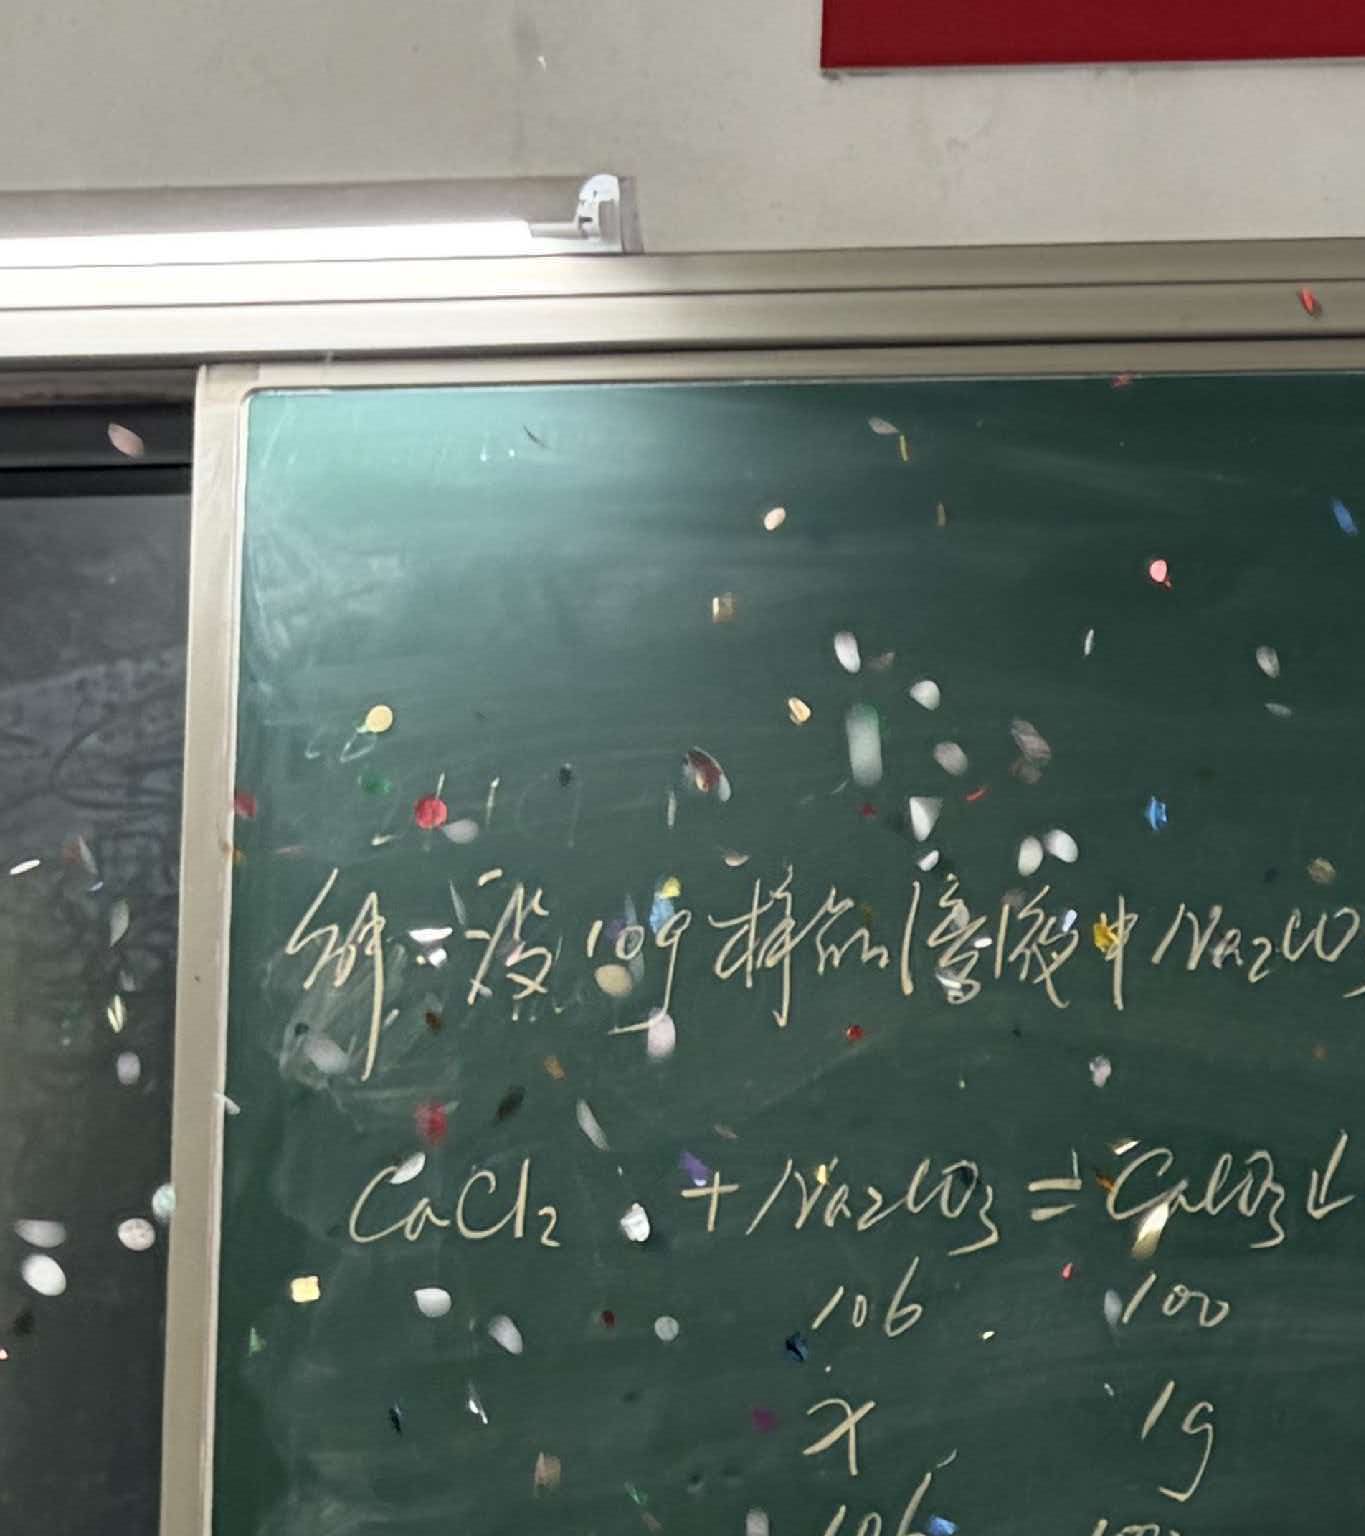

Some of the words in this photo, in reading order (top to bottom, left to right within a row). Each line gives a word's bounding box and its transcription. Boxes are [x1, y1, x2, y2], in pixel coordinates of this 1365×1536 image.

[811, 1257, 923, 1337] 106
[1122, 1273, 1229, 1328] 100
[803, 1398, 876, 1475] x
[1140, 1380, 1215, 1502] 1g
